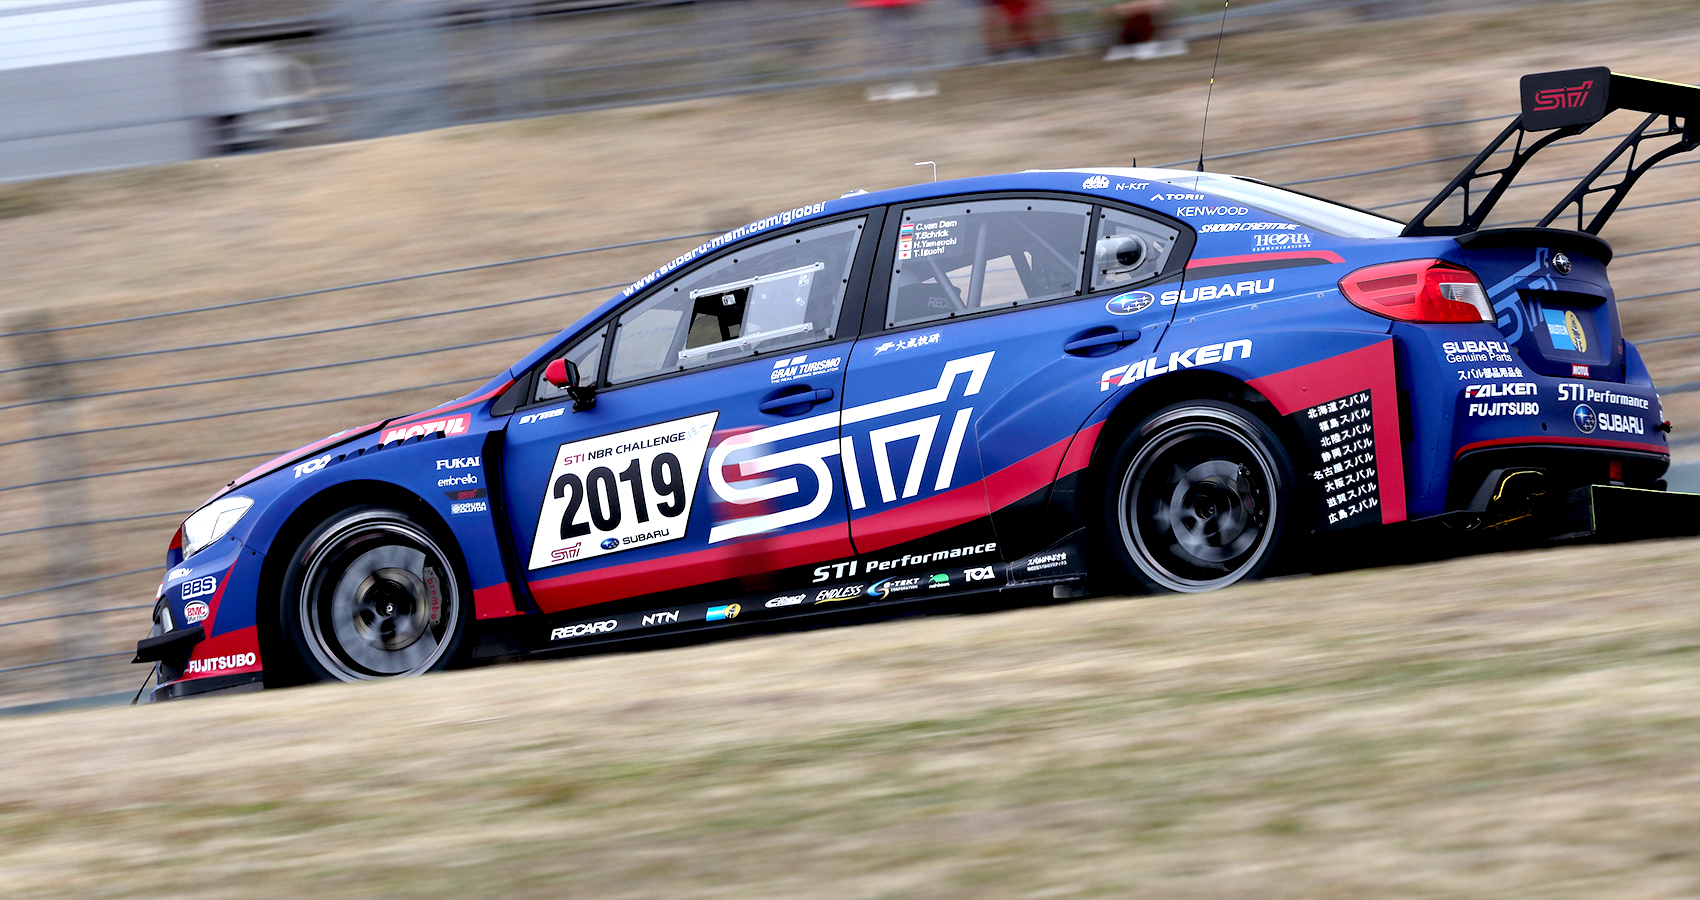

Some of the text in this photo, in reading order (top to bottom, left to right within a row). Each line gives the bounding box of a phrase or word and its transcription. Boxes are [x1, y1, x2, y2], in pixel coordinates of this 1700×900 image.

[1115, 183, 1149, 191] N-KIT
[1177, 206, 1248, 217] KENWOOD
[622, 201, 826, 297] www.subaru-msm.com/global
[1160, 278, 1275, 306] SUBARU
[1442, 341, 1509, 354] SUBARU
[1446, 353, 1512, 363] Genuine Parts
[770, 357, 841, 380] GRAN TURISMO
[1097, 339, 1253, 392] FALKEN
[1464, 383, 1538, 398] FALKEN
[1558, 383, 1584, 401] STI
[1587, 388, 1649, 410] Performance
[1307, 392, 1369, 419] 北海道スバル
[1469, 402, 1539, 417] FUJITSUBO
[1319, 407, 1370, 432] 福島スバル
[1599, 413, 1644, 435] SUBARU
[383, 418, 464, 446] MOTUL
[1320, 423, 1371, 447] 北陸スバル
[564, 431, 686, 466] STI NBR CHALLENGE
[1321, 438, 1372, 463] 静岡スバル
[293, 454, 331, 478] TOA
[436, 456, 480, 470] FUKAI
[1313, 452, 1373, 480] 名古屋スバル
[437, 473, 478, 487] embrella
[1325, 467, 1375, 493] 大阪スバル
[553, 452, 686, 540] 2019
[1328, 497, 1378, 525] 広島スバル
[623, 529, 669, 545] SUBARU
[813, 542, 996, 584] STI Performance
[963, 565, 995, 582] TOA
[182, 577, 215, 598] BBS
[815, 584, 863, 601] ENDLESS
[883, 578, 920, 588] G-TEKT
[427, 577, 439, 620] brembo
[186, 605, 206, 617] BMC
[641, 610, 679, 626] NTN
[551, 619, 618, 641] RECARO
[189, 652, 256, 673] FUJITSUBO
